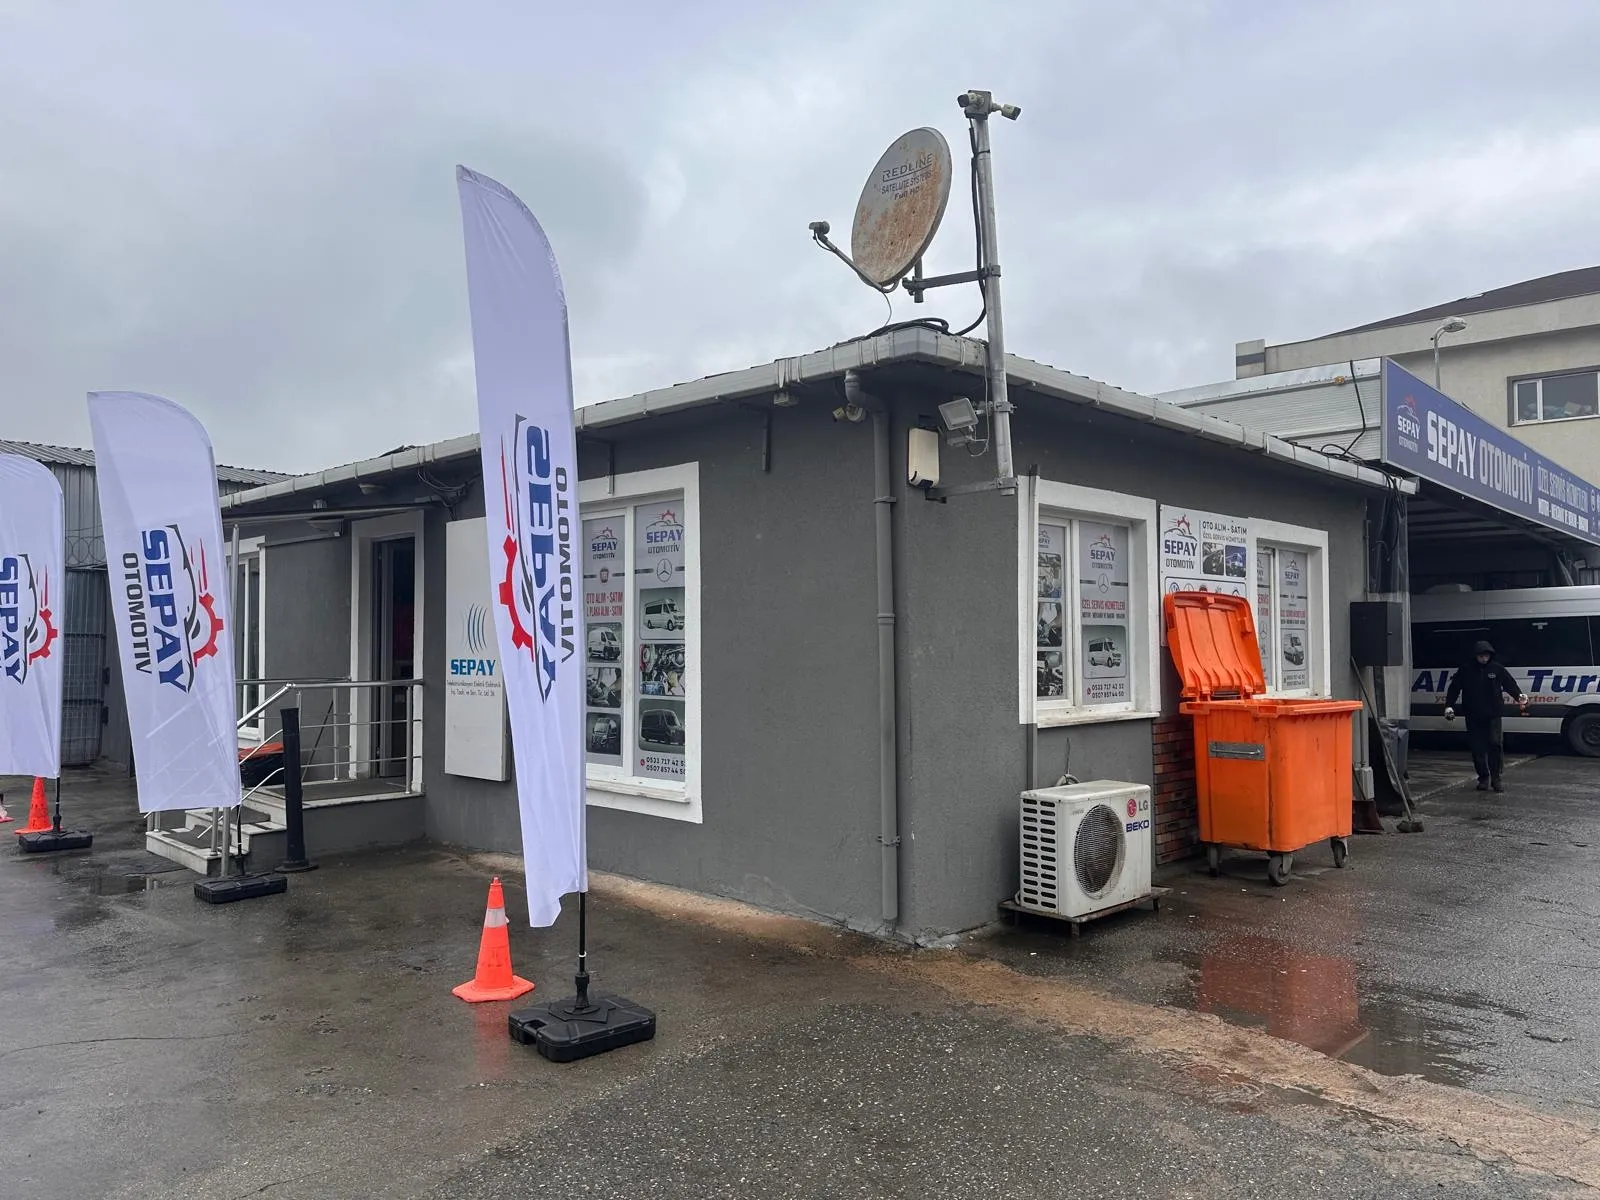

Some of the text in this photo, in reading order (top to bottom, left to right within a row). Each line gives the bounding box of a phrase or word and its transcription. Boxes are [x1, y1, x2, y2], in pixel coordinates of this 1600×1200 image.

[882, 153, 933, 181] REDLINE
[1397, 415, 1421, 439] SEPAY
[1427, 410, 1477, 480] SEPAY
[1202, 520, 1213, 530] OTO
[1214, 522, 1227, 532] ALIM
[1230, 525, 1247, 535] SATIM
[646, 529, 684, 544] SEPAY
[591, 541, 618, 552] SEPAY
[1164, 539, 1198, 557] SEPAY
[1090, 549, 1116, 561] SEPAY
[609, 591, 623, 603] SATIM
[141, 529, 188, 693] SEPAY
[0, 557, 22, 685] SEPAY
[450, 658, 497, 677] SEPAY
[1527, 669, 1600, 693] Tur
[646, 764, 660, 772] 0507
[660, 765, 670, 773] 857
[671, 766, 679, 774] 44
[1138, 800, 1149, 811] LG
[1125, 820, 1150, 833] BEKO
